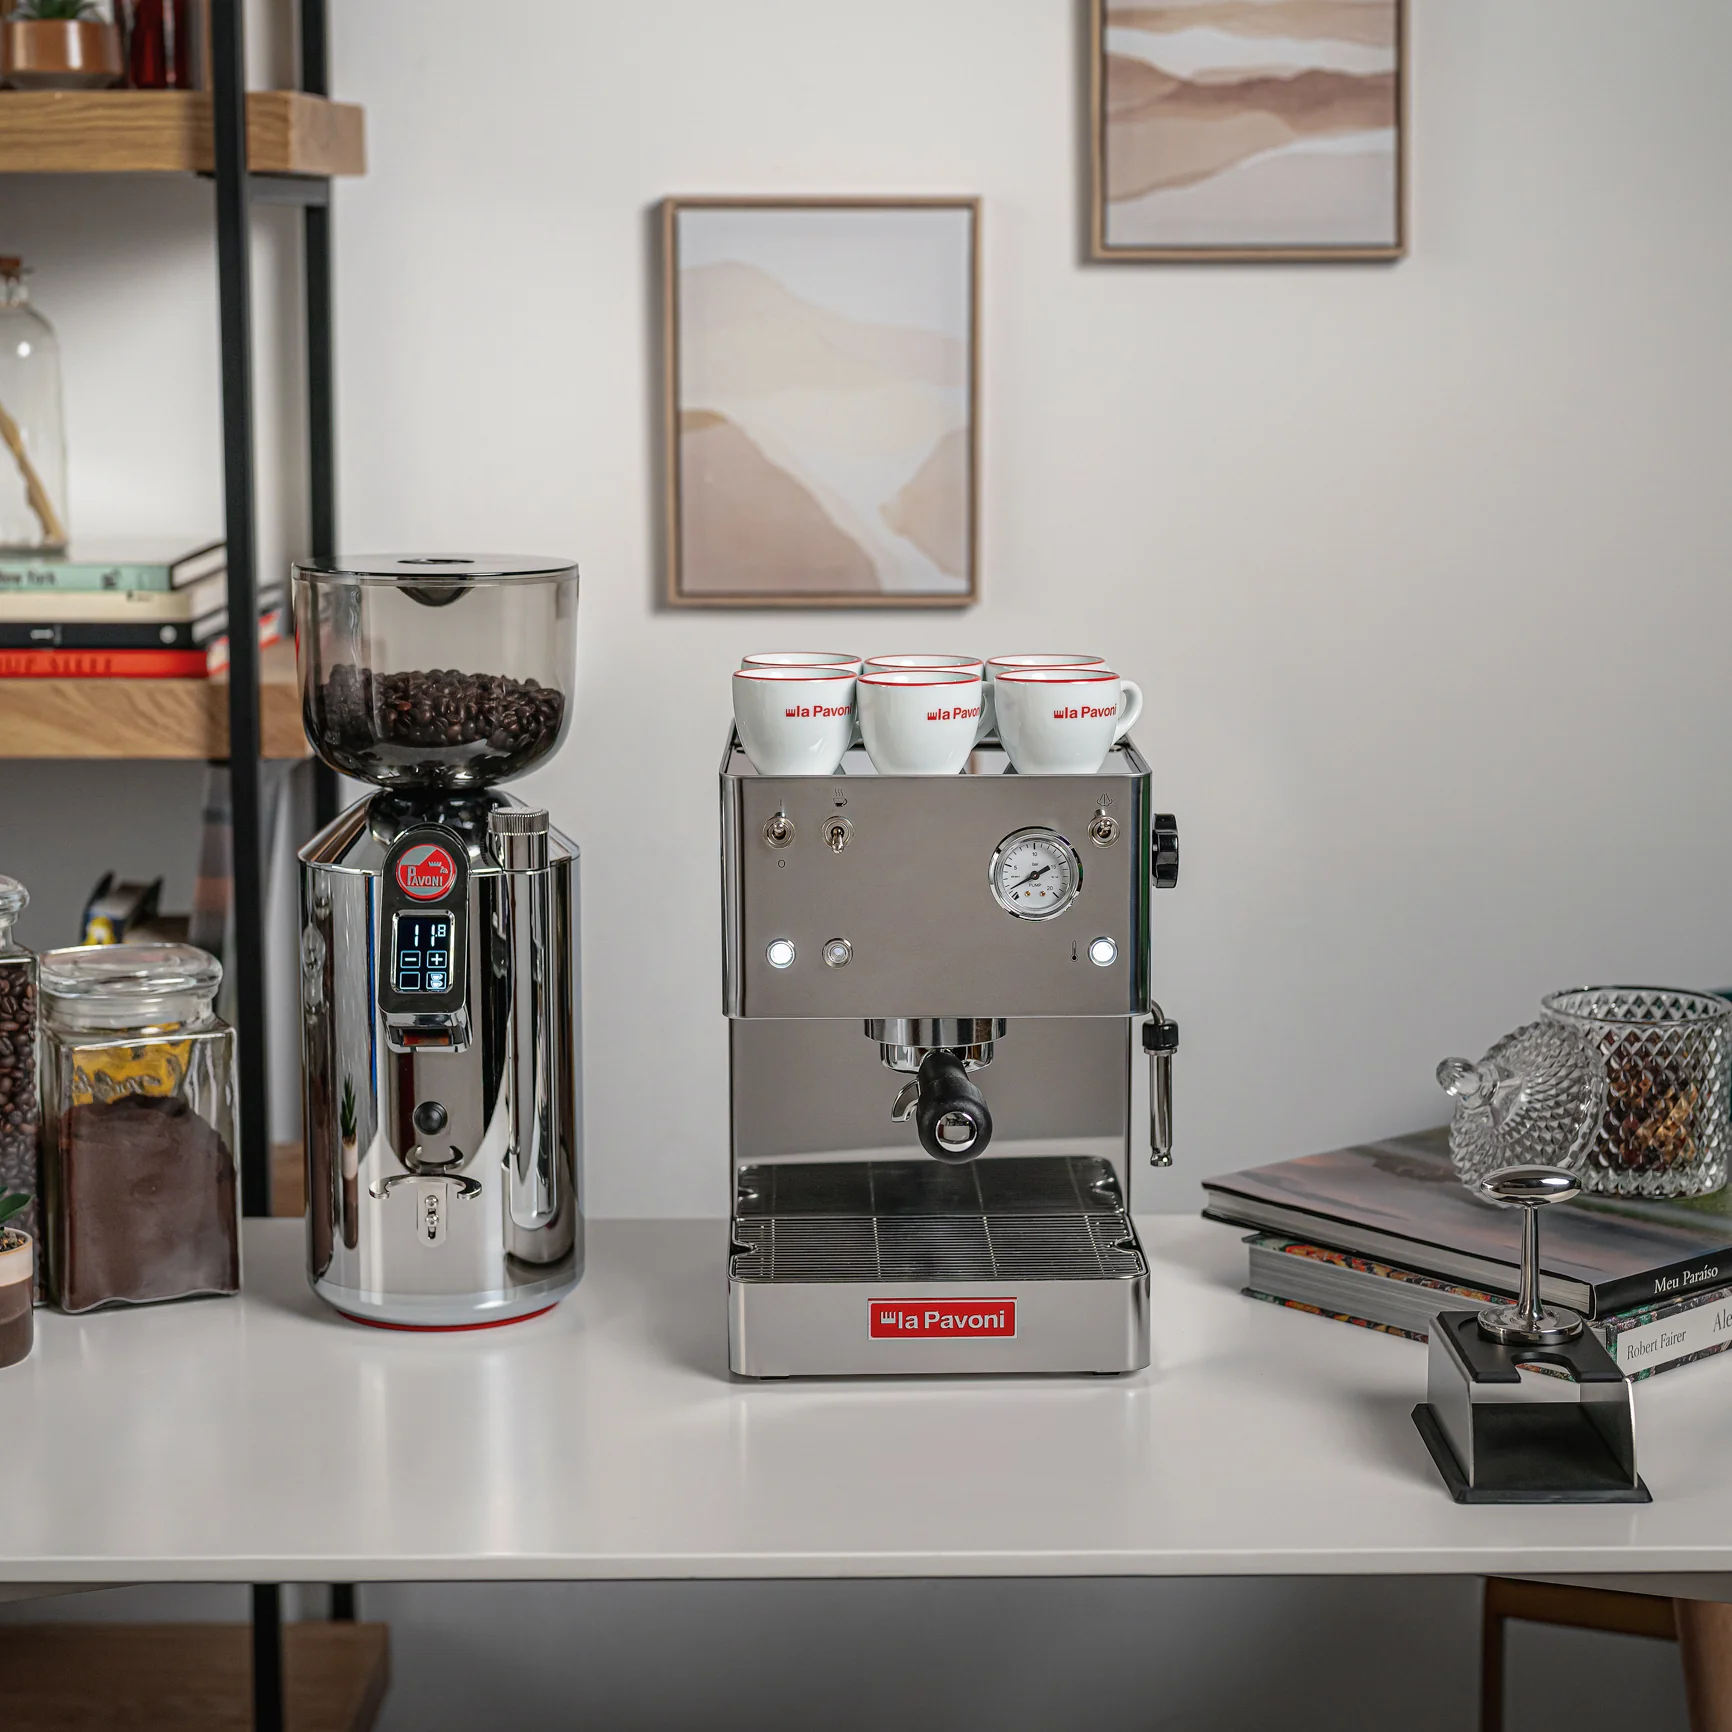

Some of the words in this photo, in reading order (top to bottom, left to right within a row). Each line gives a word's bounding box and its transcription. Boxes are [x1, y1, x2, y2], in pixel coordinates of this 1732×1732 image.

[796, 706, 810, 718] la
[938, 709, 950, 721] la
[1065, 706, 1078, 719] la
[1081, 703, 1117, 719] Pavoni
[1653, 1276, 1680, 1295] Meu
[1682, 1264, 1719, 1286] Paraíso
[898, 1311, 919, 1329] la
[924, 1310, 1005, 1329] Pavoni
[1626, 1340, 1658, 1360] Robert
[1660, 1331, 1687, 1349] Fairer
